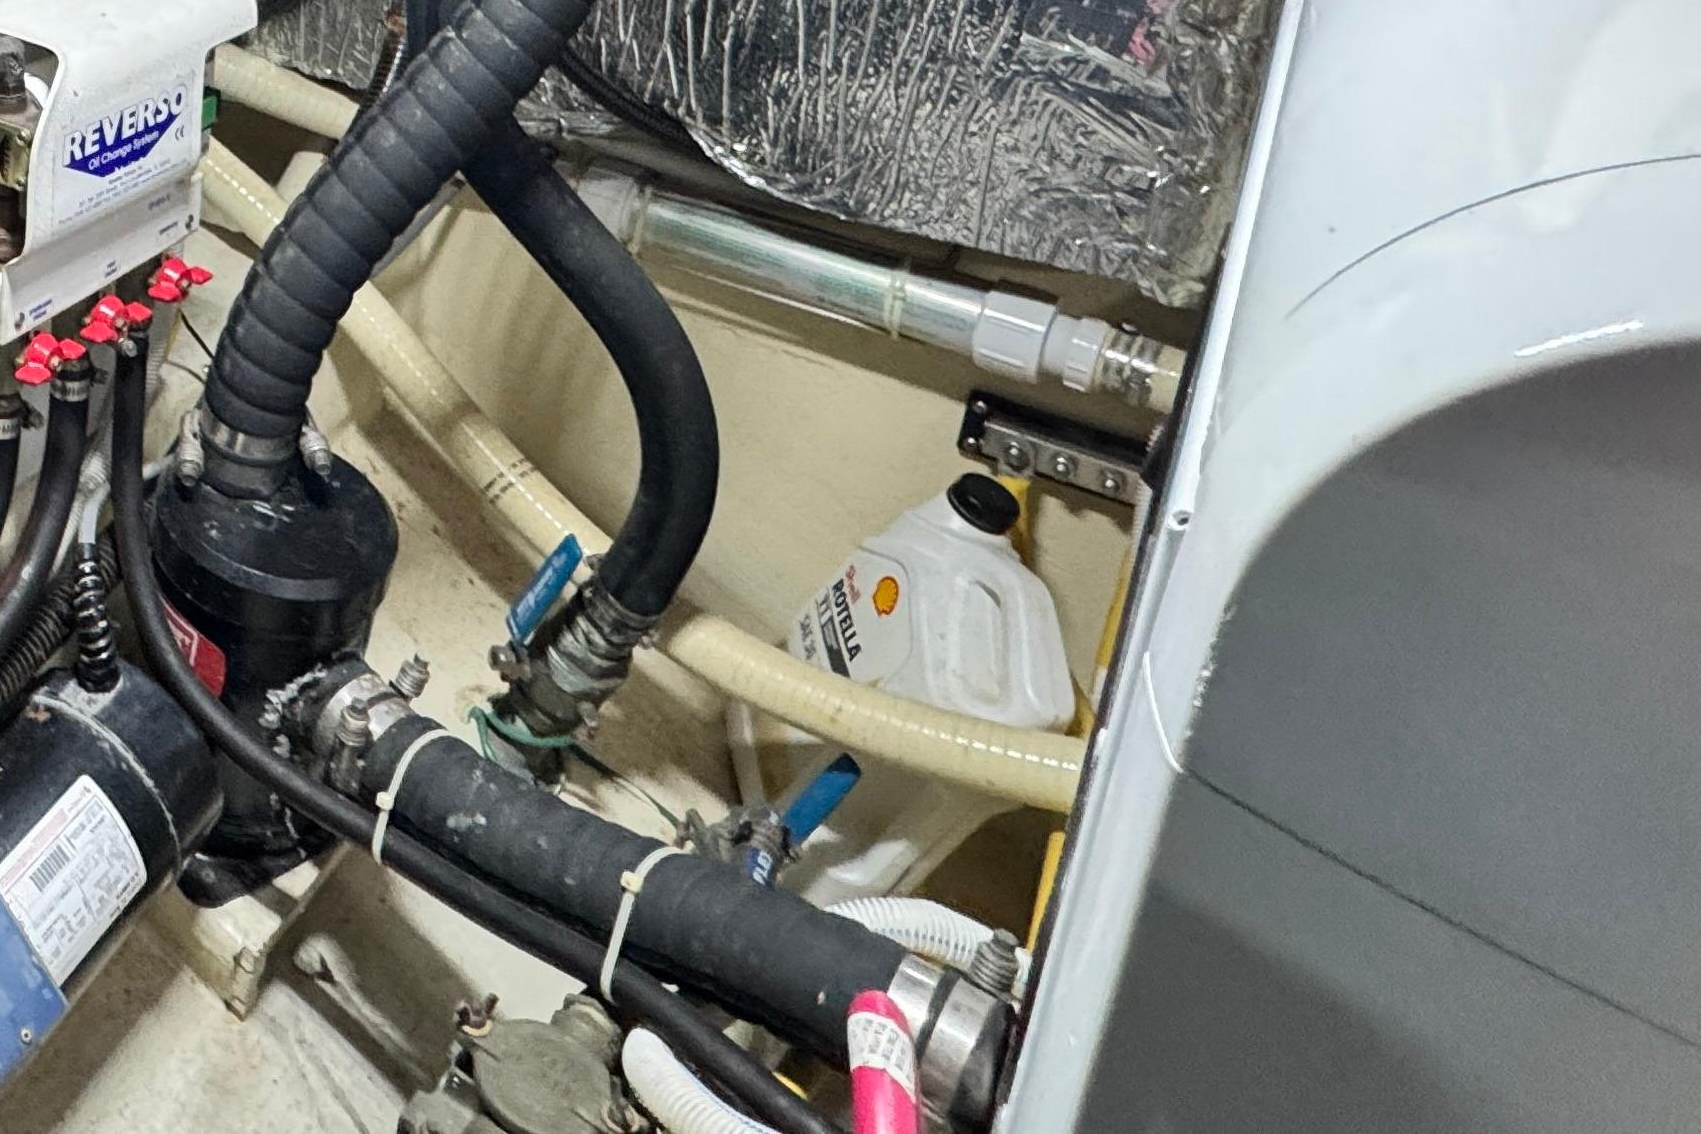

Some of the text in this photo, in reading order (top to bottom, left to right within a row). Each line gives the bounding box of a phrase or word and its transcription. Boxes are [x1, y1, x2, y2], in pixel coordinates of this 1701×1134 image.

[62, 84, 187, 167] REVERSO
[88, 130, 159, 170] Oil Change System
[832, 578, 862, 662] ROTELLA
